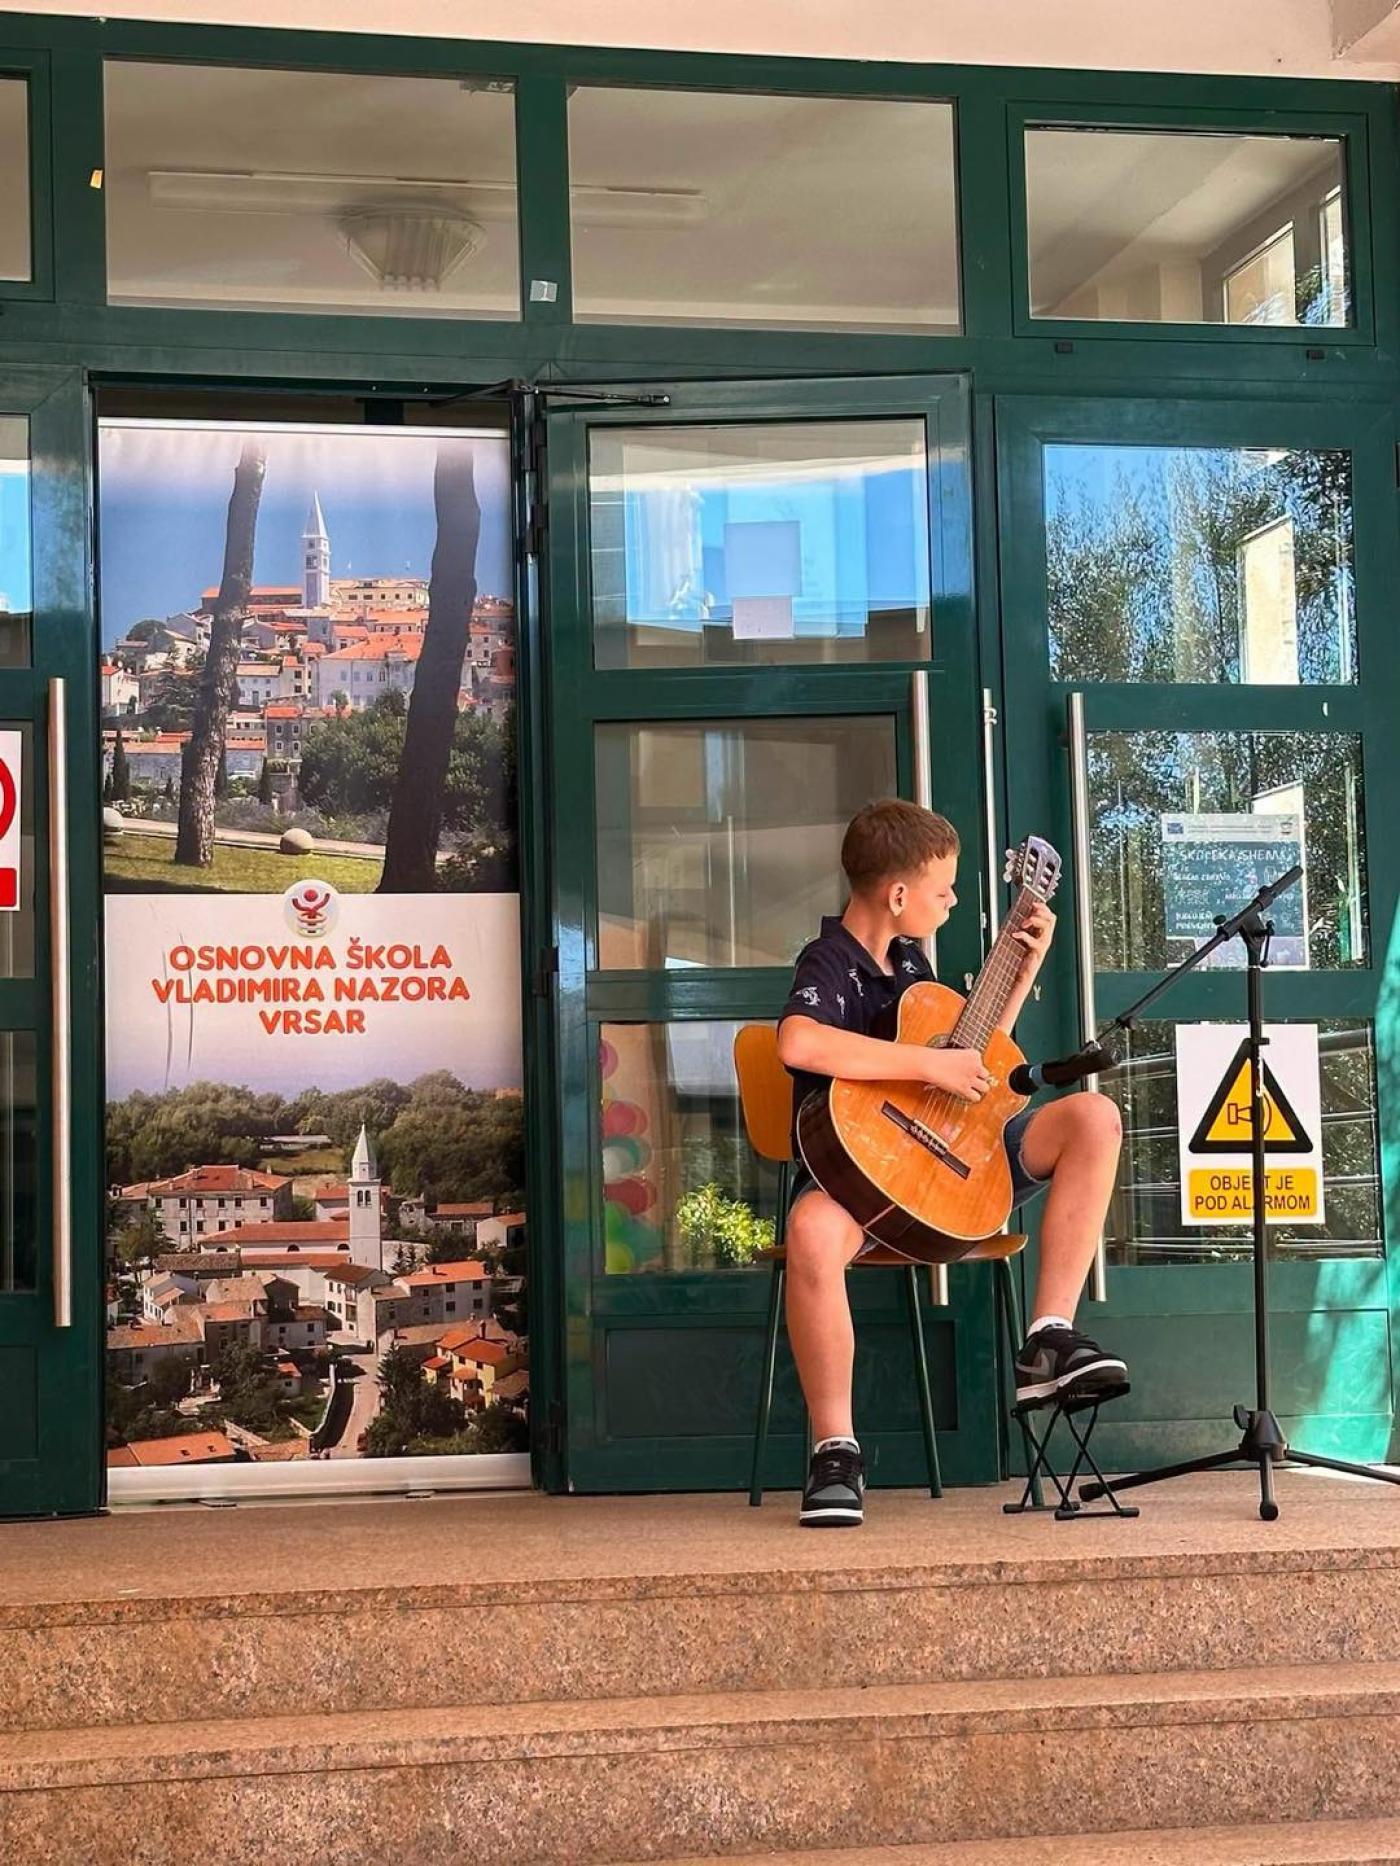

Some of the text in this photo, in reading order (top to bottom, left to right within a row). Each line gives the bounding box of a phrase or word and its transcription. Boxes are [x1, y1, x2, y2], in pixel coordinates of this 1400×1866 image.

[169, 937, 452, 971] OSNOVNA ŠKOLA
[152, 976, 470, 1003] VLADIMIRA NAZORA
[259, 1009, 366, 1034] VRSAR
[1210, 1175, 1294, 1190] OBJET JE
[1194, 1195, 1310, 1210] POD ALRMOM
